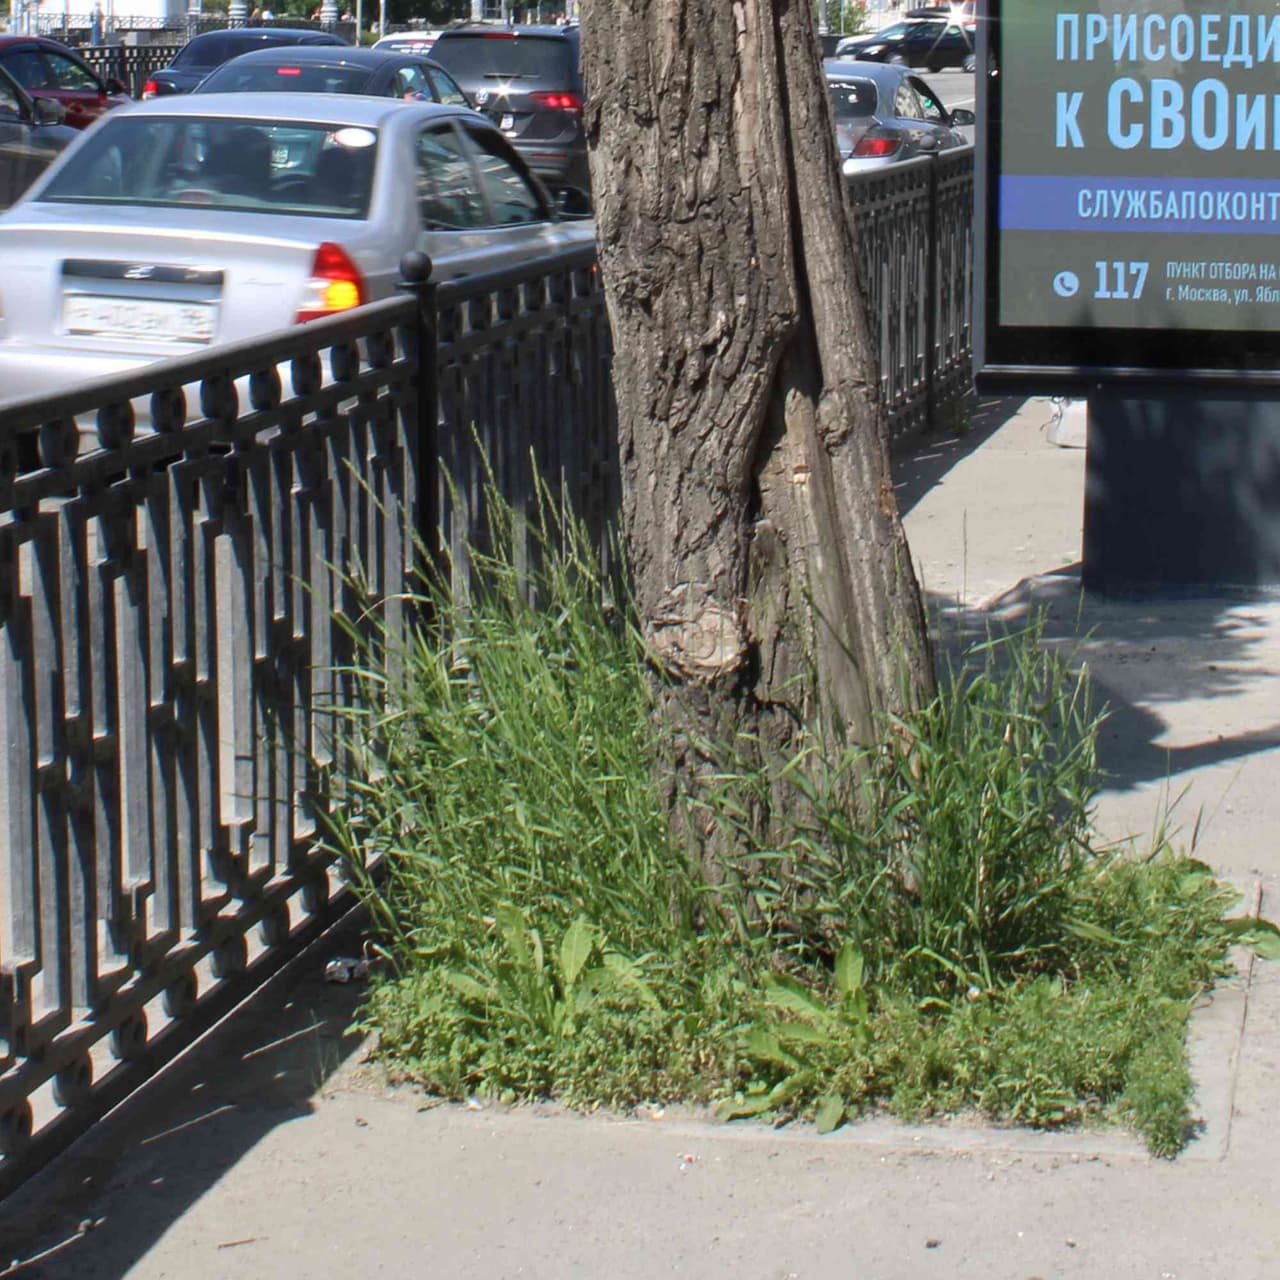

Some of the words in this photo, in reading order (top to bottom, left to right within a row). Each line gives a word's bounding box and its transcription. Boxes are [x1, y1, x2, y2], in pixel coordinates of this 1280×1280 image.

[1094, 261, 1150, 300] 117
[1166, 261, 1206, 279] ПУНКТ
[1209, 262, 1257, 281] ОТБОРА
[1259, 263, 1277, 281] НА
[1166, 286, 1176, 301] г.
[1178, 284, 1232, 305] Москва,
[1233, 289, 1253, 306] ул.
